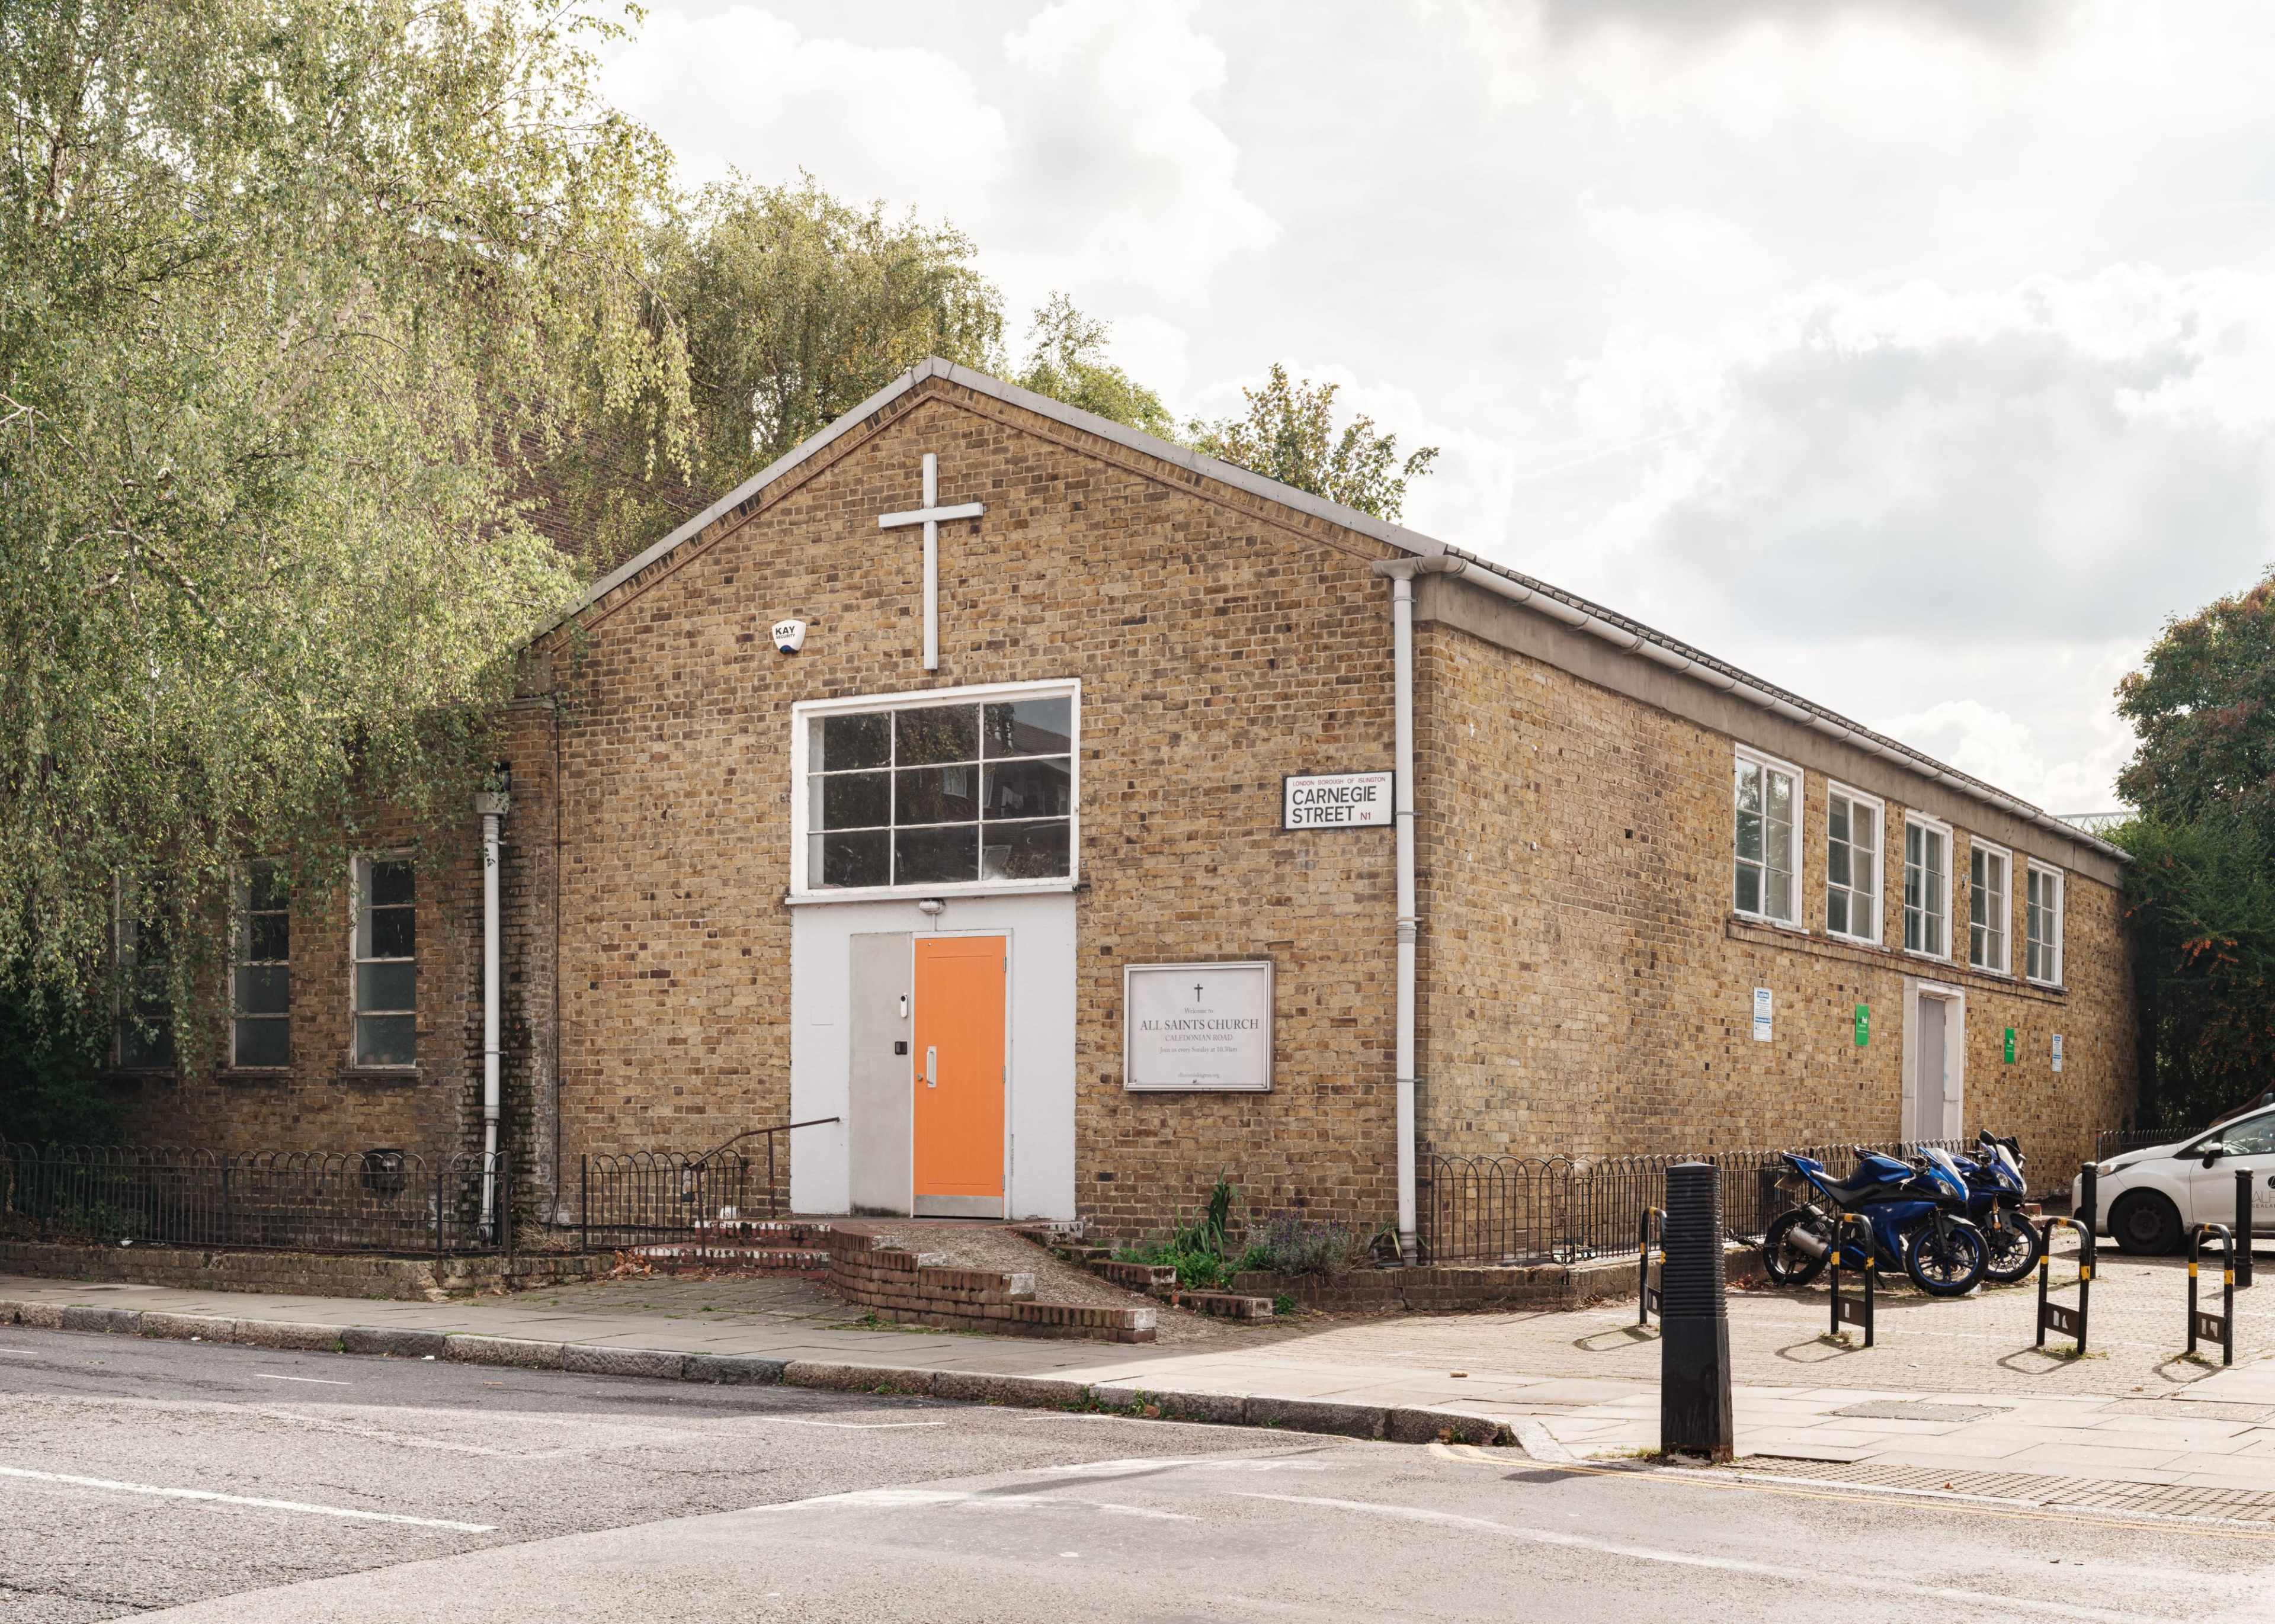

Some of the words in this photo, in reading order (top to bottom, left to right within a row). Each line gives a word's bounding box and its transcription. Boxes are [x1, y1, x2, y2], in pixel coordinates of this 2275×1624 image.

[776, 626, 795, 635] KAY
[1292, 785, 1376, 805] CARNEGIE
[1292, 805, 1355, 823] STREET
[1360, 812, 1371, 820] N1
[1140, 1019, 1162, 1031] ALL
[1165, 1019, 1205, 1031] SAINTS
[1207, 1019, 1259, 1030] CHURCH
